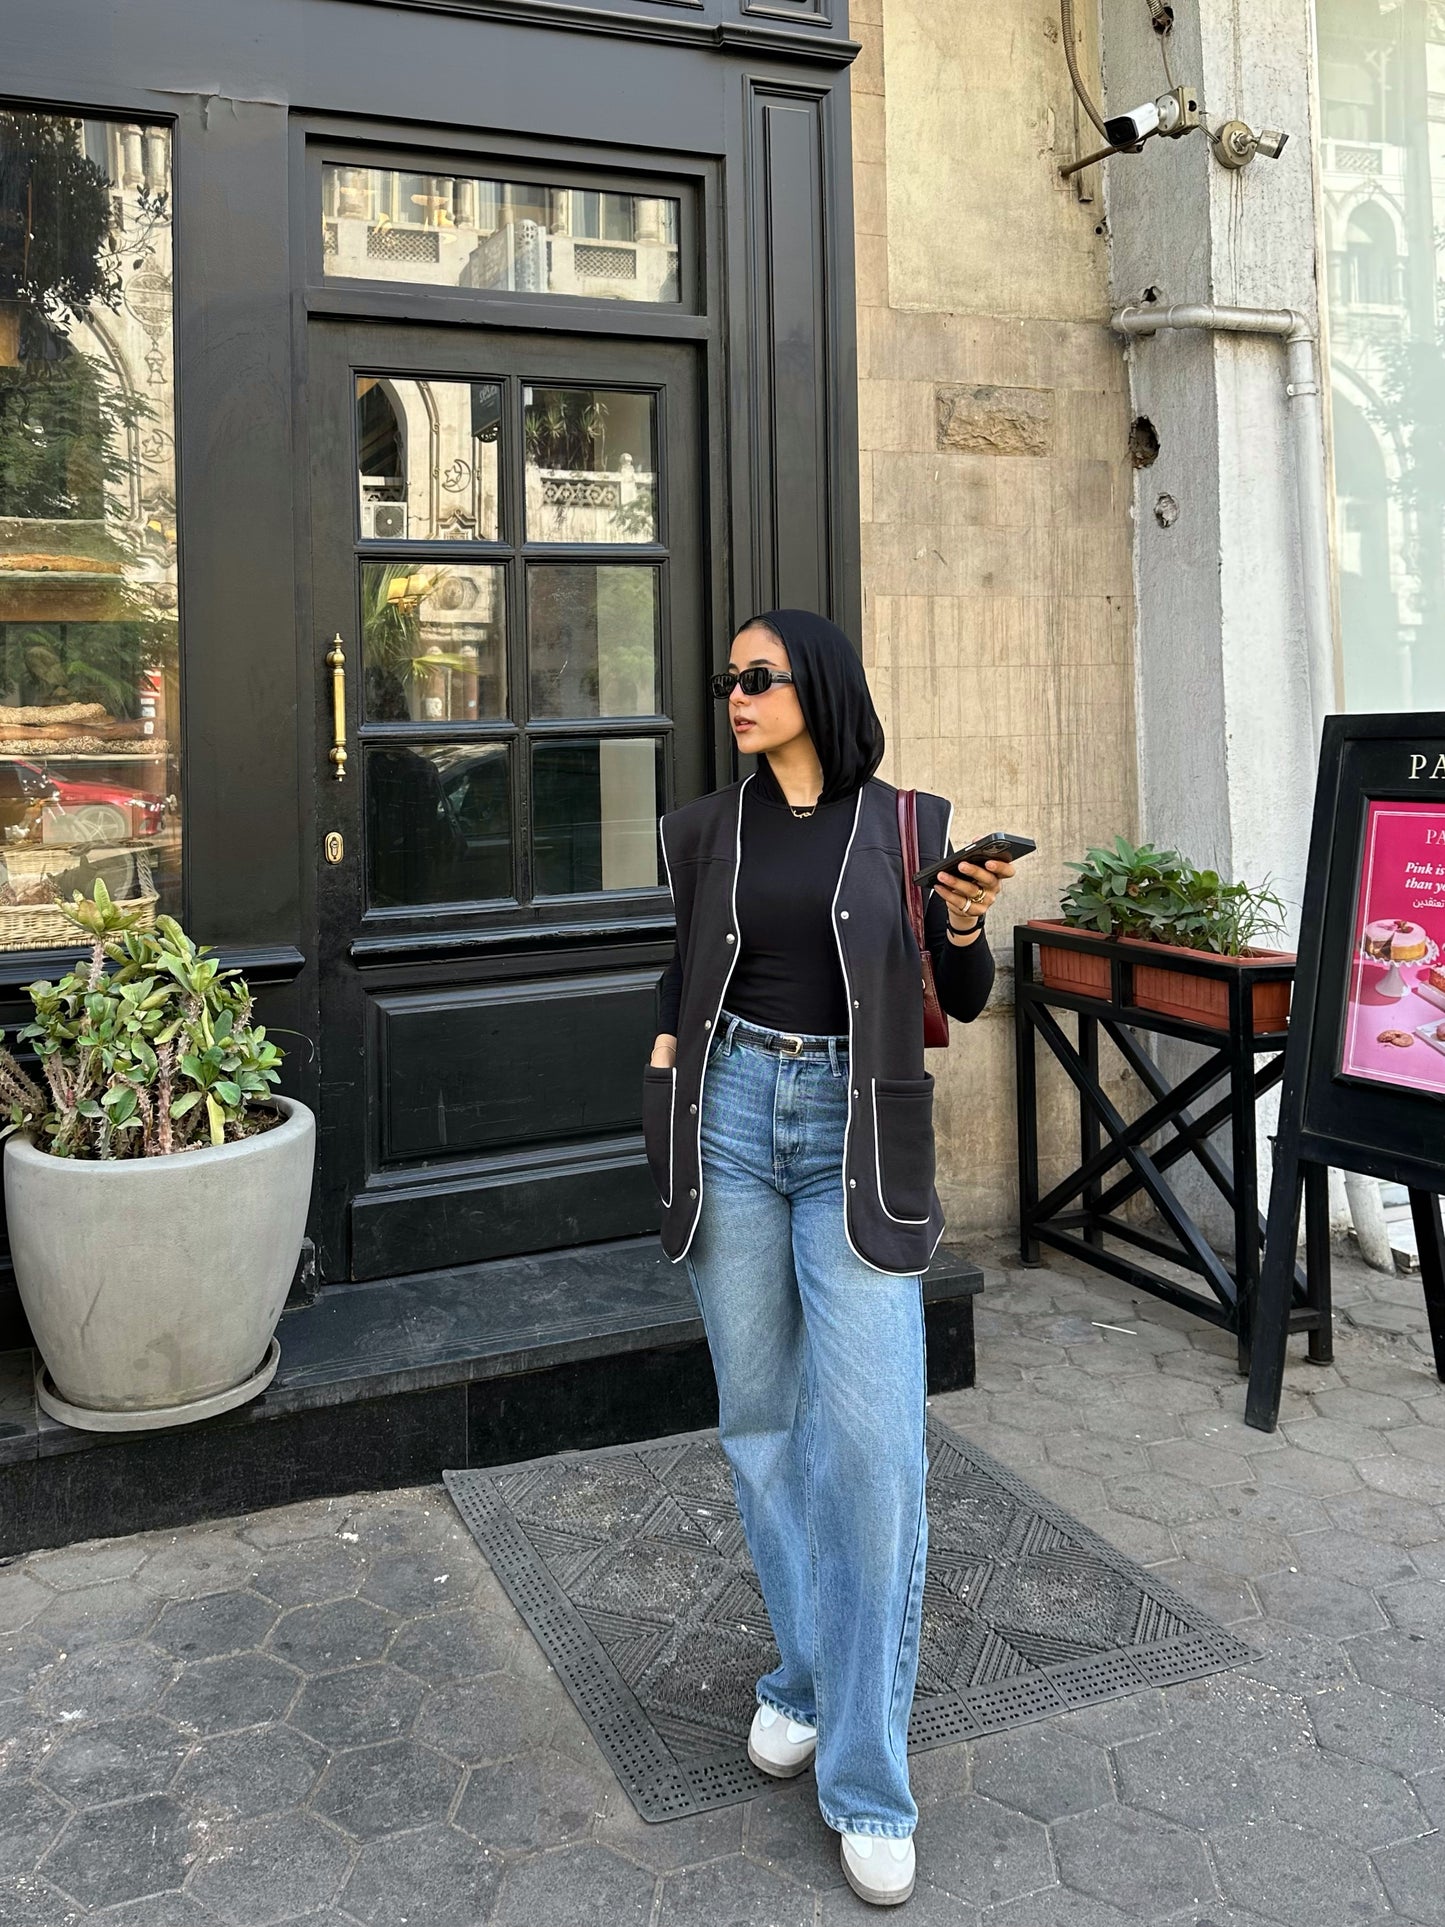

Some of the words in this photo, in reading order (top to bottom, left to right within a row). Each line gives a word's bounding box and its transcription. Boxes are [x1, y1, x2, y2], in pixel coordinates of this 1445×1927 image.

[1408, 754, 1445, 779] PA
[1425, 829, 1445, 845] PA
[1405, 862, 1433, 874] Pink
[1435, 864, 1445, 875] is
[1405, 877, 1433, 890] than
